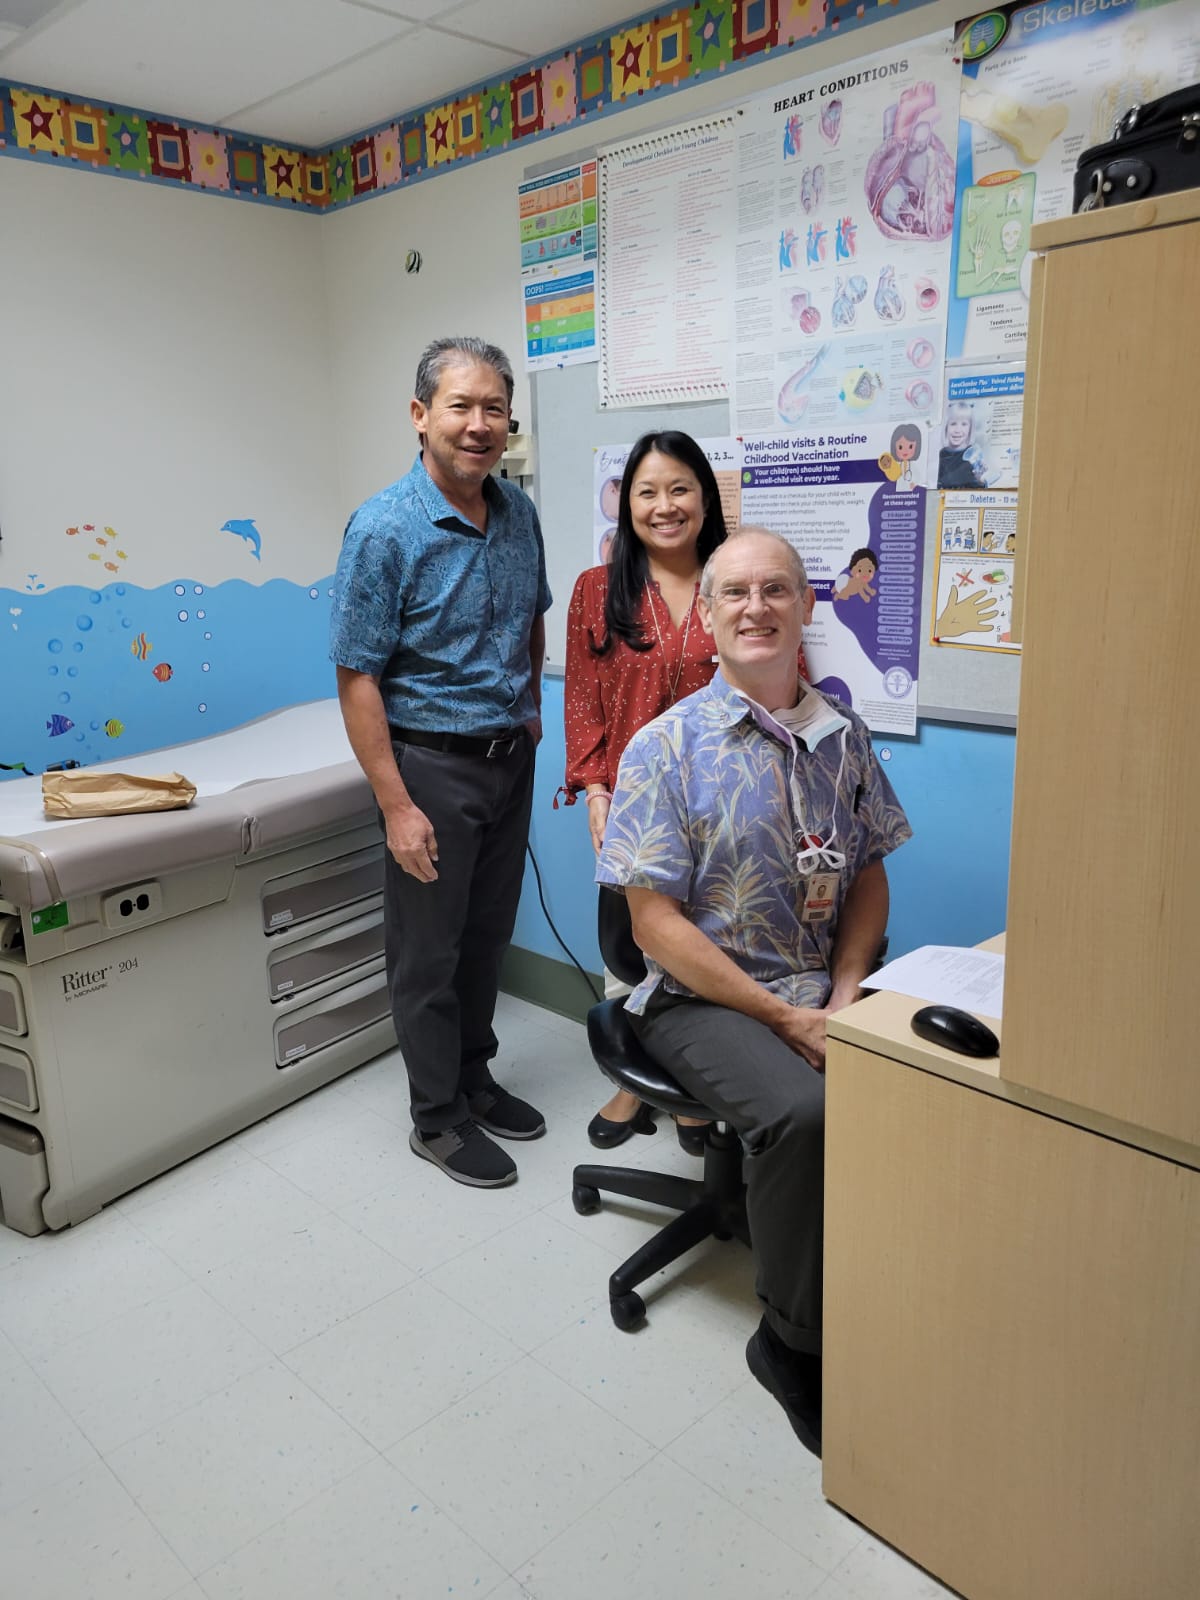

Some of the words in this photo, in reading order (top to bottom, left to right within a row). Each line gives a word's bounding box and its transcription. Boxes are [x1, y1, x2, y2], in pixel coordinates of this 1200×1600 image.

[773, 89, 815, 114] HEART
[820, 59, 909, 96] CONDITIONS
[622, 152, 653, 168] Developmental
[654, 147, 673, 160] Checklist
[681, 141, 697, 150] Young
[697, 136, 719, 147] Children
[526, 284, 544, 296] OOPS!
[976, 304, 1004, 312] Ligaments
[1004, 331, 1026, 339] Cartilag
[744, 440, 789, 452] Well-child
[791, 438, 816, 448] visits
[818, 438, 825, 446] &
[827, 434, 868, 446] Routine
[714, 452, 721, 461] 2,
[744, 452, 790, 464] Childhood
[792, 450, 848, 461] Vaccination
[770, 466, 800, 475] child(ren)
[970, 494, 996, 504] Diabetes
[62, 967, 108, 994] Ritter
[118, 958, 138, 974] 204
